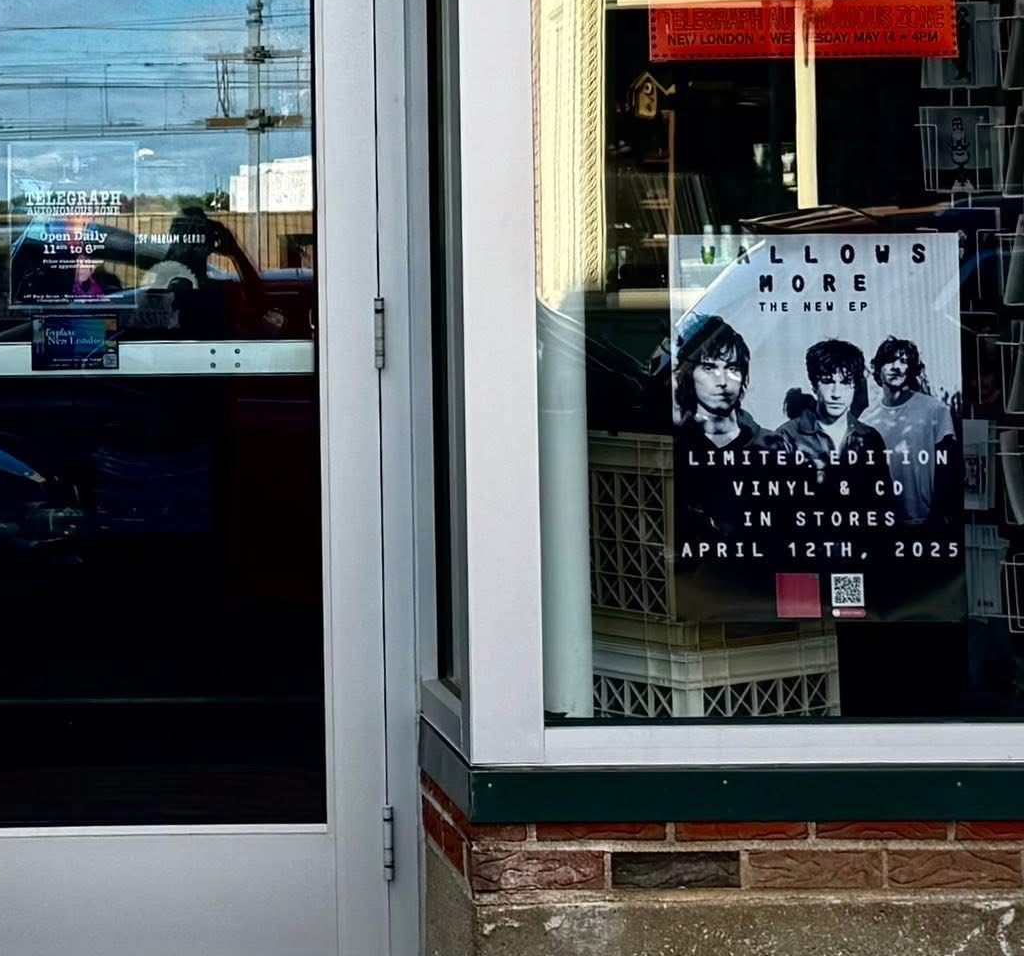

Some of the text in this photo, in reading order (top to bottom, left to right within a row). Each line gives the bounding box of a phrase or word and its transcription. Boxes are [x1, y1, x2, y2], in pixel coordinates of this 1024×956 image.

[665, 5, 945, 30] TELEGRAPH AUNOMOUS ZONE
[668, 33, 697, 45] NEW
[700, 33, 754, 45] LONDON
[854, 32, 880, 43] MAY
[911, 31, 939, 43] 4PM
[25, 190, 123, 206] TELEGRAPH
[40, 230, 108, 243] Open Daily
[70, 244, 83, 254] to
[701, 243, 927, 265] WALLOWS
[759, 274, 867, 293] MORE
[759, 301, 869, 312] THE NEW EP
[688, 449, 949, 466] LIMITED EDITION
[733, 481, 904, 496] VINYL & CD
[743, 511, 896, 527] IN STORES
[681, 542, 959, 559] APRIL 12TH, 2025
